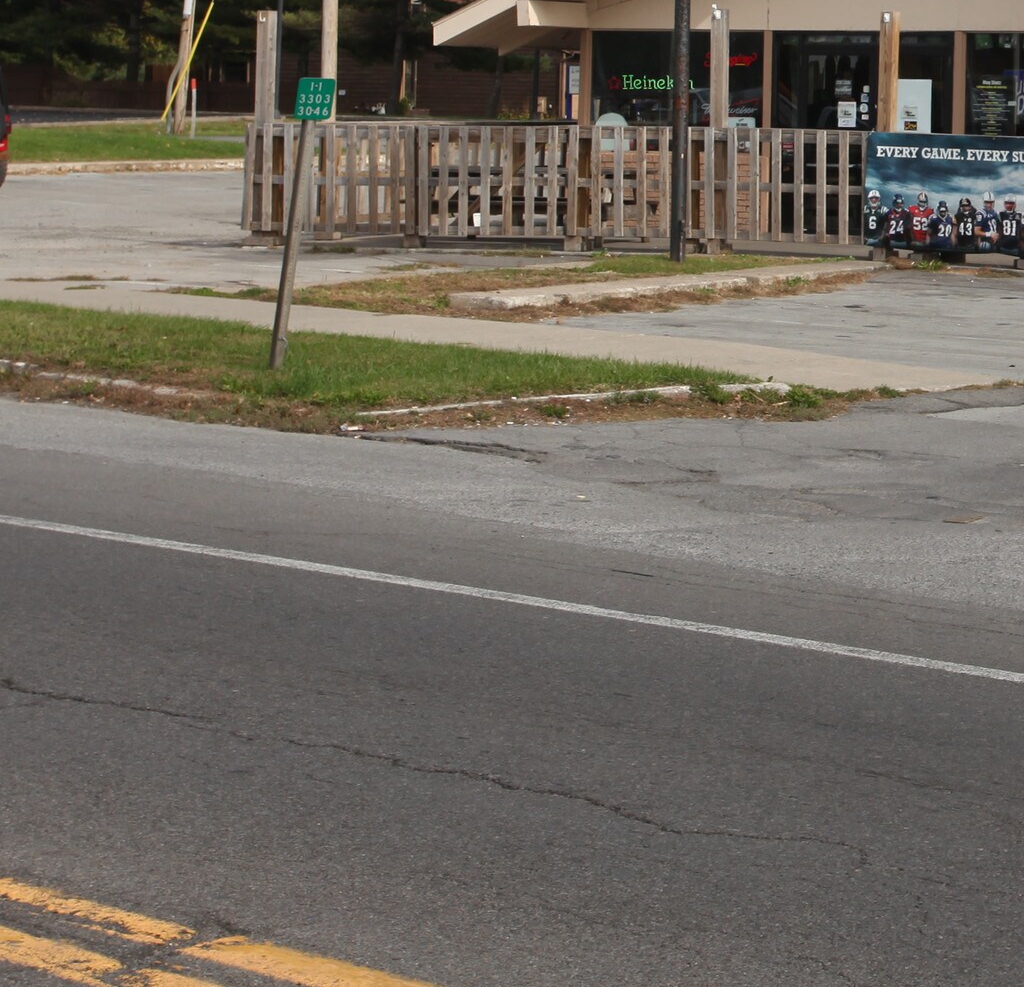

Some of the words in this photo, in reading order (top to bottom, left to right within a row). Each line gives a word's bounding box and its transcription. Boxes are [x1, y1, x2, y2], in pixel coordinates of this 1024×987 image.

[622, 74, 695, 90] Heinekn
[299, 93, 331, 104] 3303
[876, 145, 919, 159] EVERY
[921, 147, 964, 161] GAME.
[966, 148, 1010, 163] EVERY
[868, 215, 877, 230] 6
[888, 220, 904, 235] 24
[913, 216, 928, 231] 52
[958, 222, 973, 236] 43
[1002, 219, 1017, 236] 81
[937, 224, 952, 237] 20
